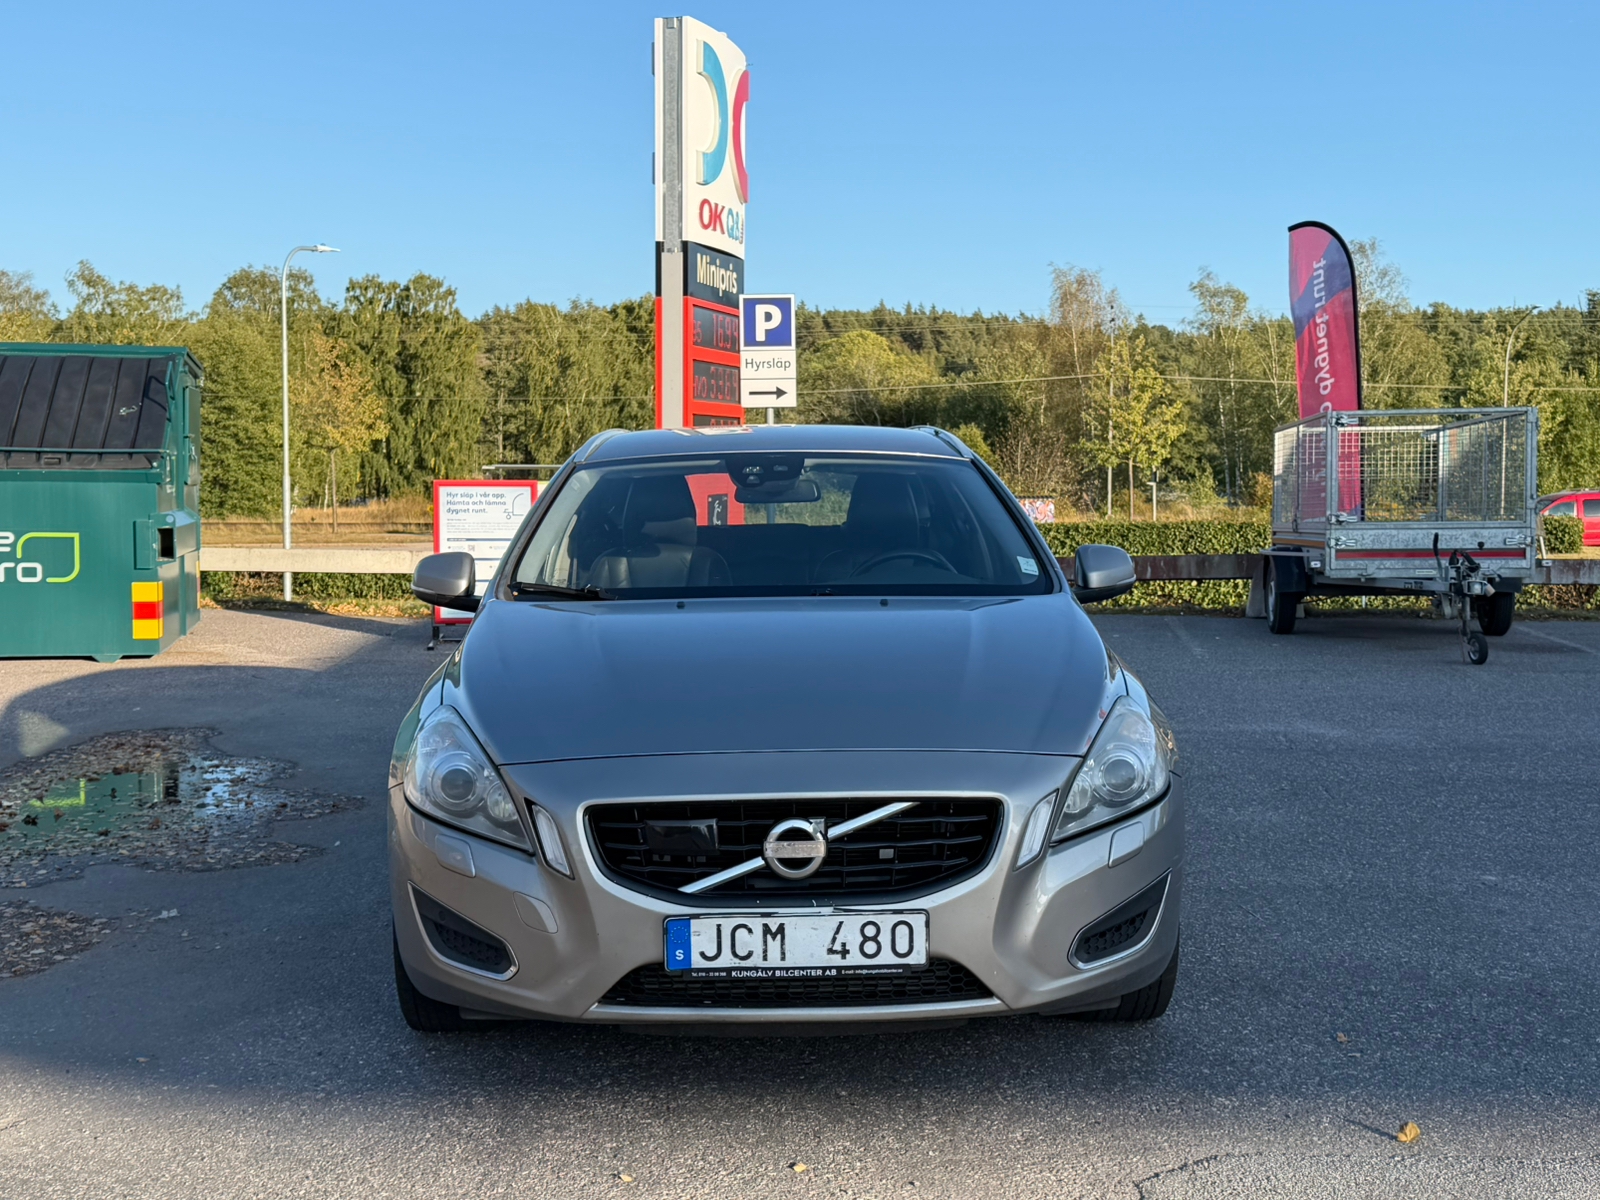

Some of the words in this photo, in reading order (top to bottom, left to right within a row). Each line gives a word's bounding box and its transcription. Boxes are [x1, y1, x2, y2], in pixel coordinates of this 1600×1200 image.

[697, 253, 738, 297] Minipris
[754, 303, 782, 342] P
[745, 358, 791, 371] Hyrsläp
[446, 491, 459, 499] Hyr
[460, 491, 474, 499] släp
[446, 507, 470, 515] dygnet
[698, 922, 786, 962] JCM
[827, 919, 915, 961] 480
[675, 949, 685, 961] S
[731, 969, 773, 977] KUNGÄLV
[775, 969, 823, 977] BILCENTER
